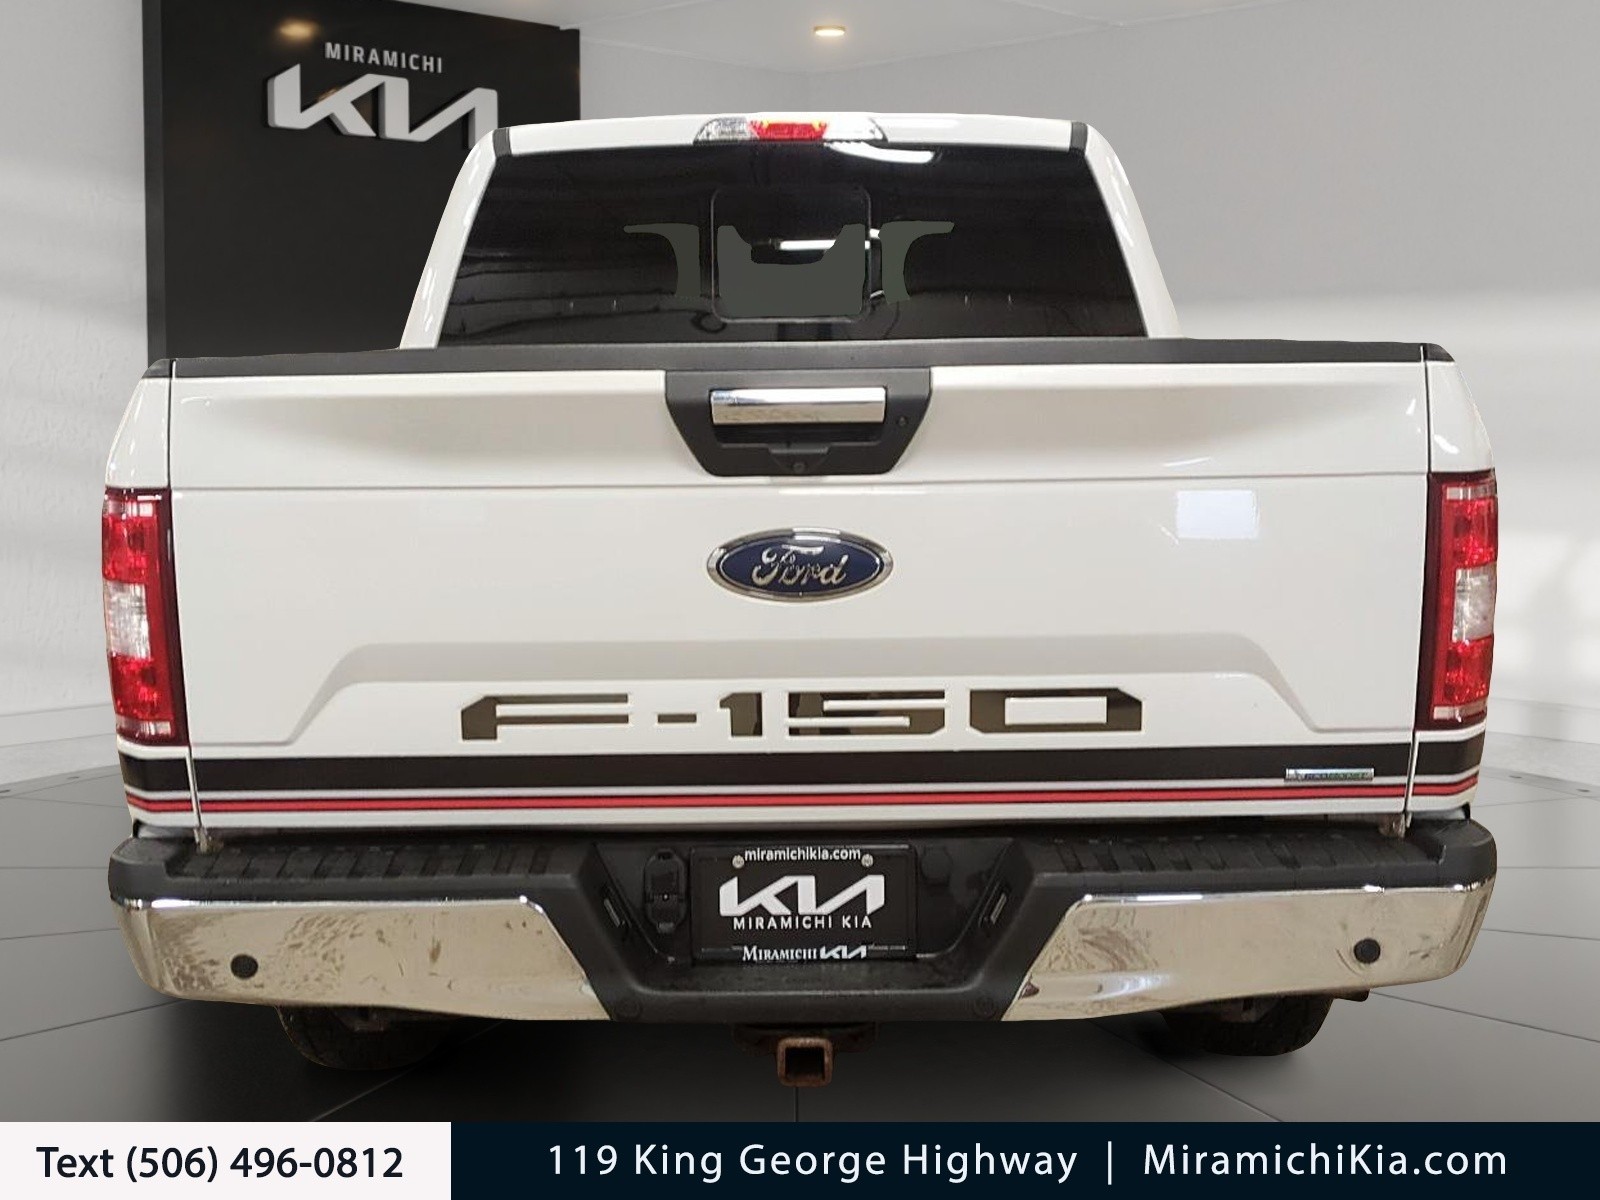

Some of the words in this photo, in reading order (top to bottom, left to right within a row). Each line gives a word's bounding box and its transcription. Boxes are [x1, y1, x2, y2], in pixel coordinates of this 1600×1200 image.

[324, 41, 443, 74] MIRAMICHI
[266, 63, 498, 150] KIA
[751, 544, 850, 586] Ford
[460, 687, 1143, 741] F-150
[744, 847, 861, 862] miramichikia.com
[719, 874, 885, 917] KIA
[733, 915, 832, 930] MIRAMICHI
[841, 914, 873, 929] KIA
[819, 945, 867, 960] KIA
